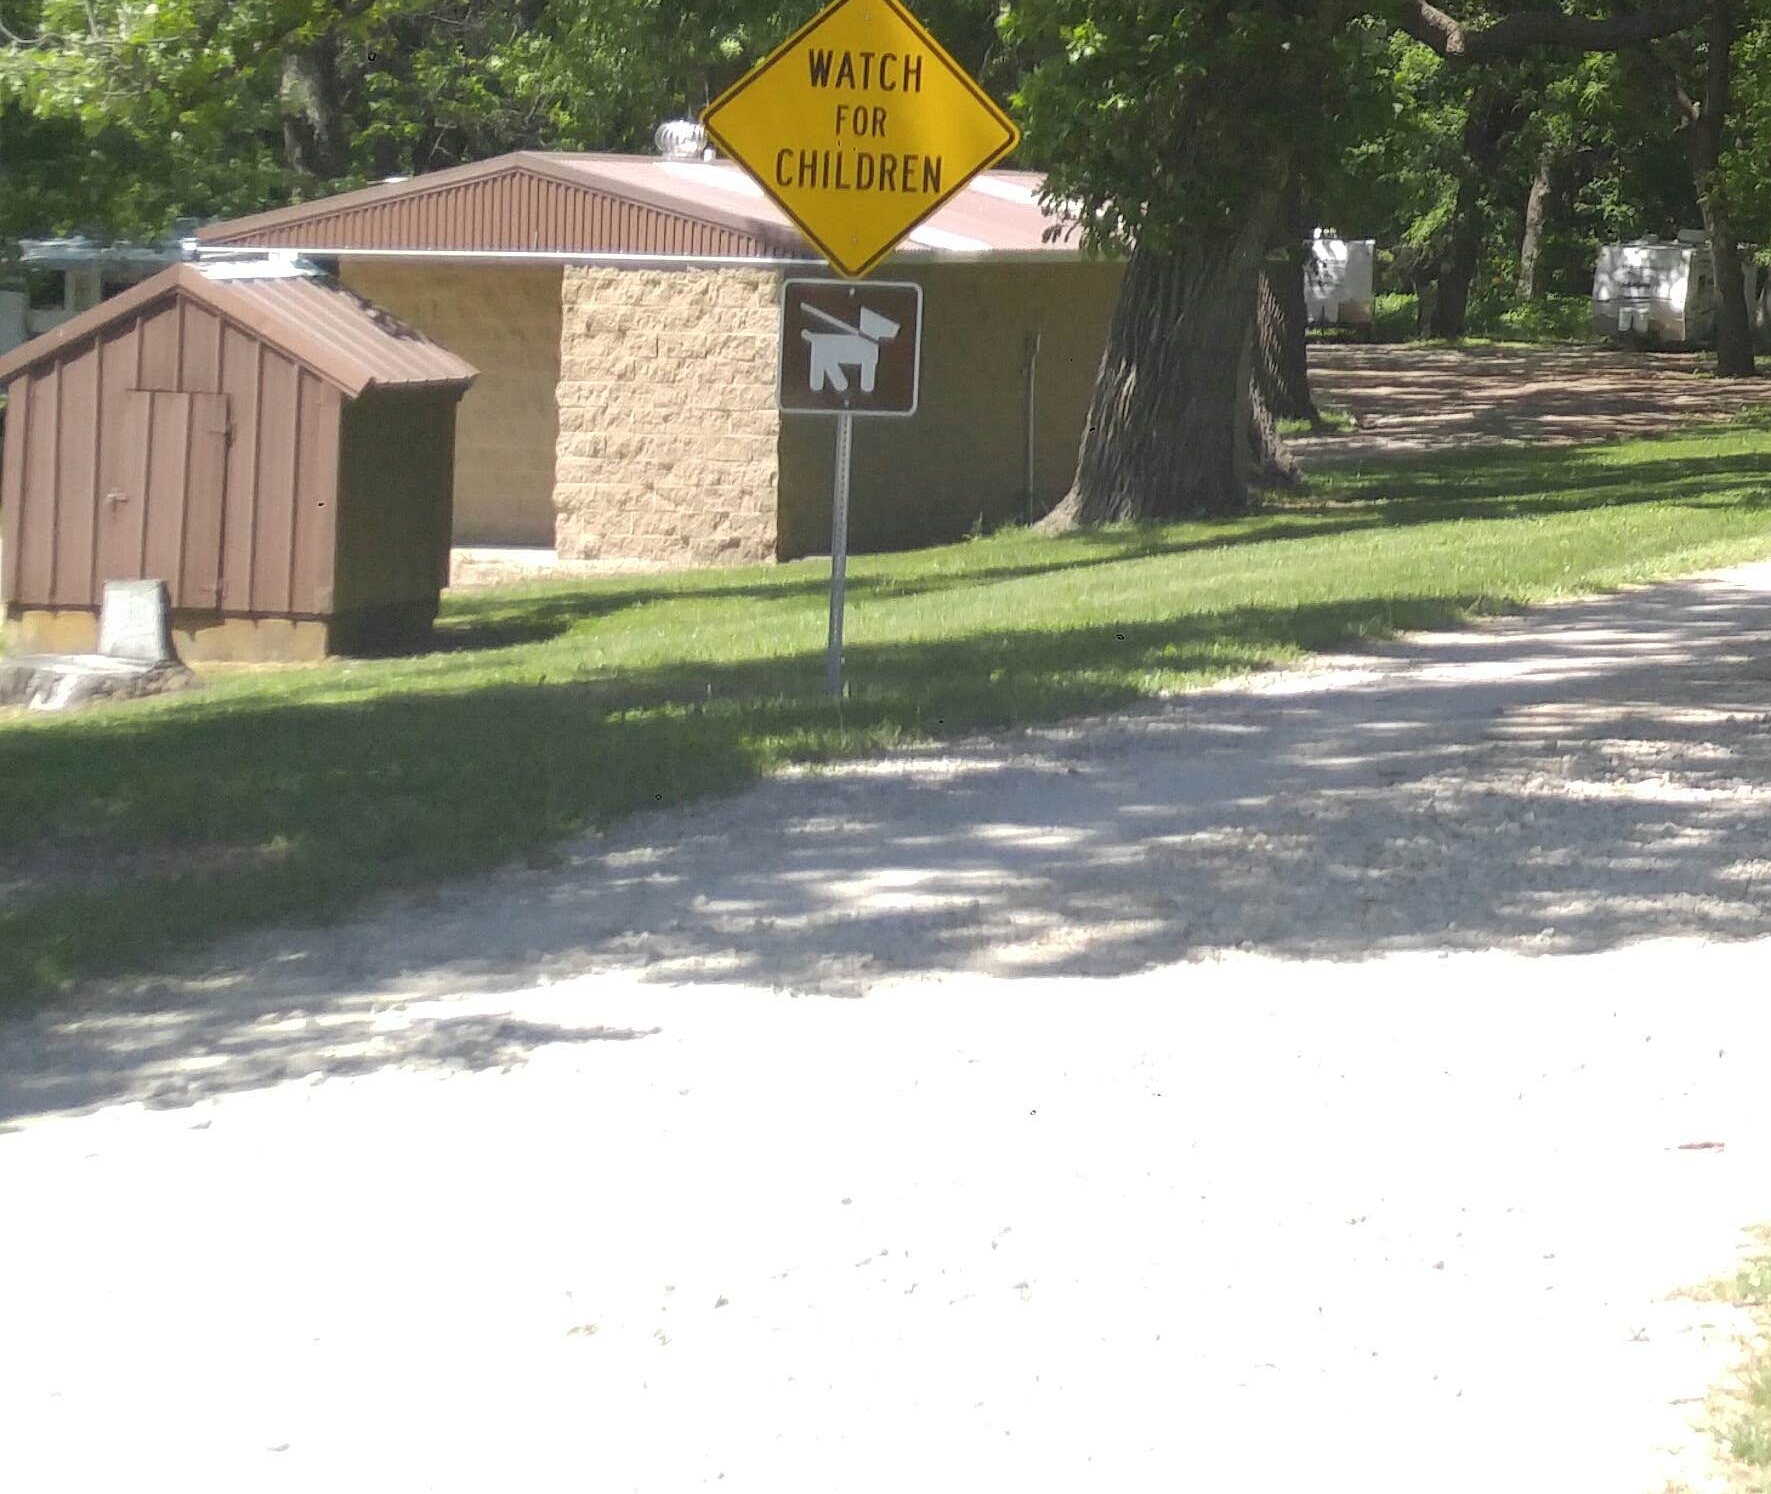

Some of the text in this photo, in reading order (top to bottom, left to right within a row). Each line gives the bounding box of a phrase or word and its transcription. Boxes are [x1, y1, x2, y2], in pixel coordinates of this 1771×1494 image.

[809, 48, 922, 93] WATCH
[835, 104, 887, 138] FOR
[776, 148, 942, 194] CHILDREN
